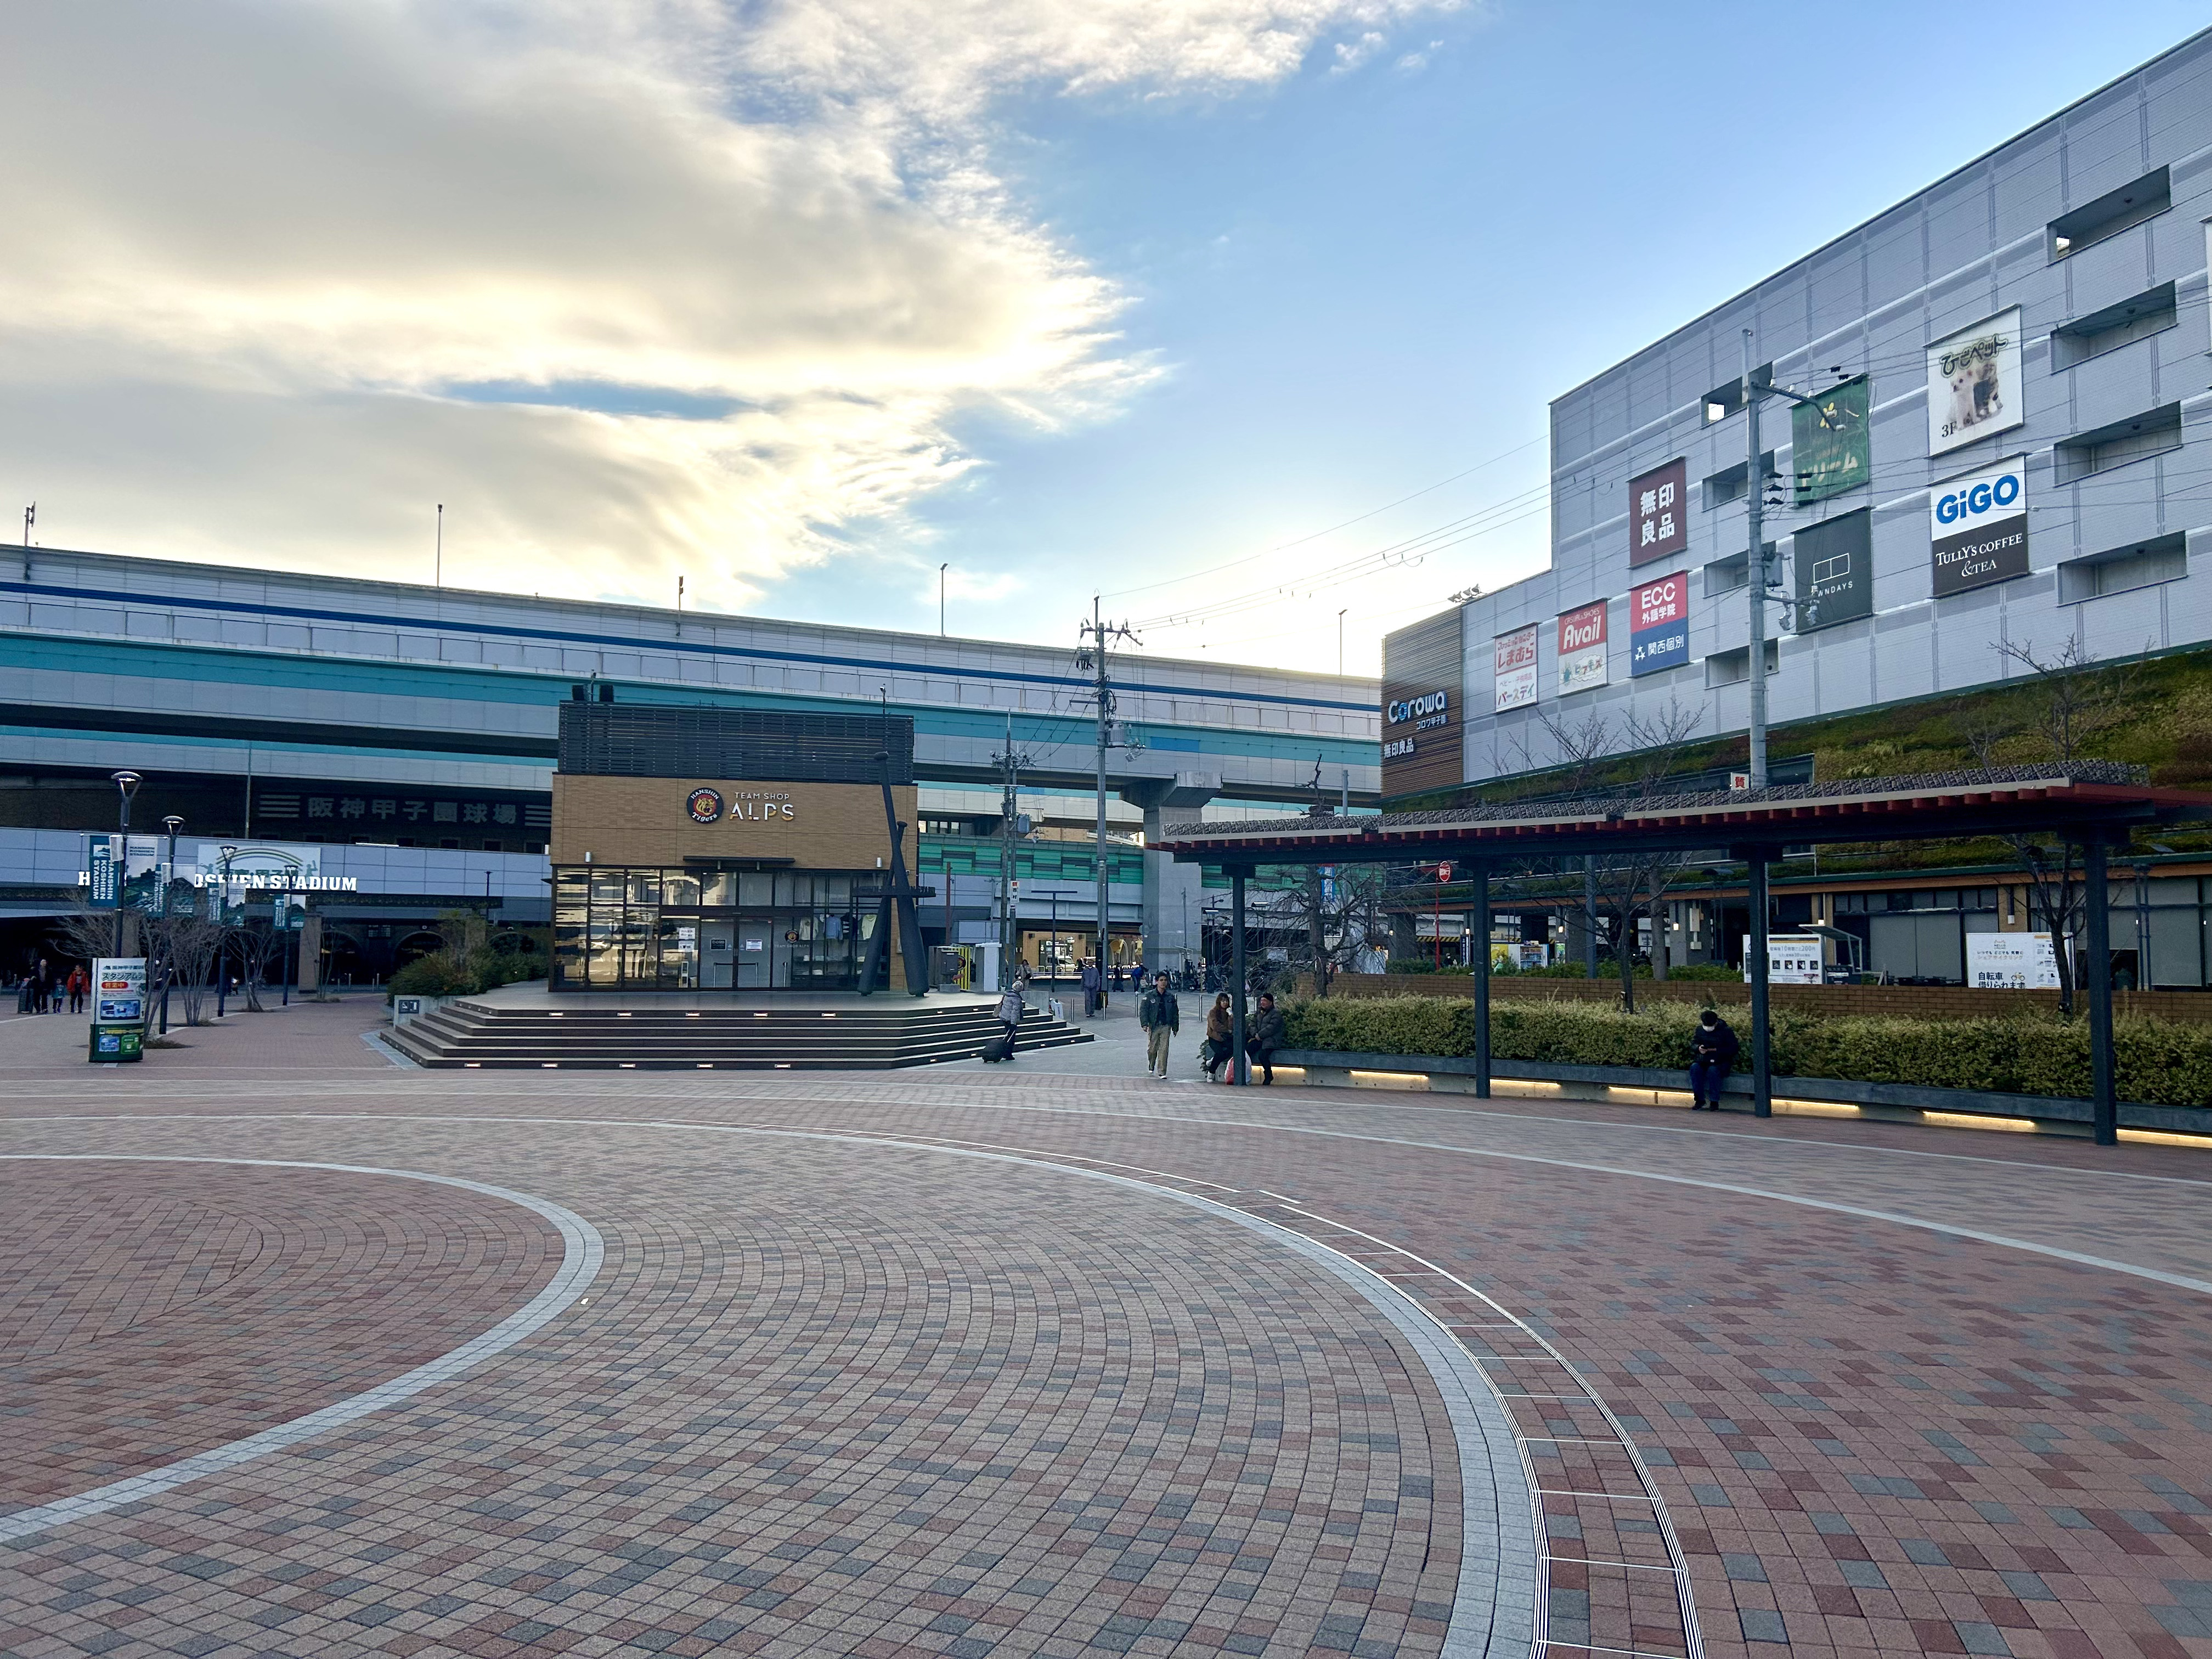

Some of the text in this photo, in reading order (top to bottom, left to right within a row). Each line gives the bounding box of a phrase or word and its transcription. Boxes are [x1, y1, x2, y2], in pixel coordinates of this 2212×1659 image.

[1940, 334, 2007, 376] ひごペット
[1942, 421, 1957, 437] 3F
[1640, 482, 1674, 517] 無印
[1936, 475, 2019, 524] GiGO
[1641, 512, 1675, 548] 良品
[1979, 533, 2023, 555] COFFEE
[1641, 582, 1676, 610] ECC
[1812, 581, 1853, 599] WNDAYS
[1642, 603, 1676, 624] 外語学院
[1564, 615, 1601, 650] Avail
[1498, 642, 1534, 669] しまむら
[1647, 634, 1684, 657] 関西個別
[1498, 683, 1534, 706] バースデイ
[1388, 691, 1446, 723] Corowa
[1416, 714, 1446, 730] コロワ甲子園
[1384, 738, 1414, 759] 無印良品
[1735, 776, 1745, 788] 質
[690, 788, 719, 800] HANSHIN
[308, 797, 517, 824] 阪神甲子園球場
[691, 811, 718, 822] Tigers
[729, 802, 794, 821] ALPS
[194, 873, 357, 891] OSIEN STADIUM
[1978, 972, 2004, 980] 自転車
